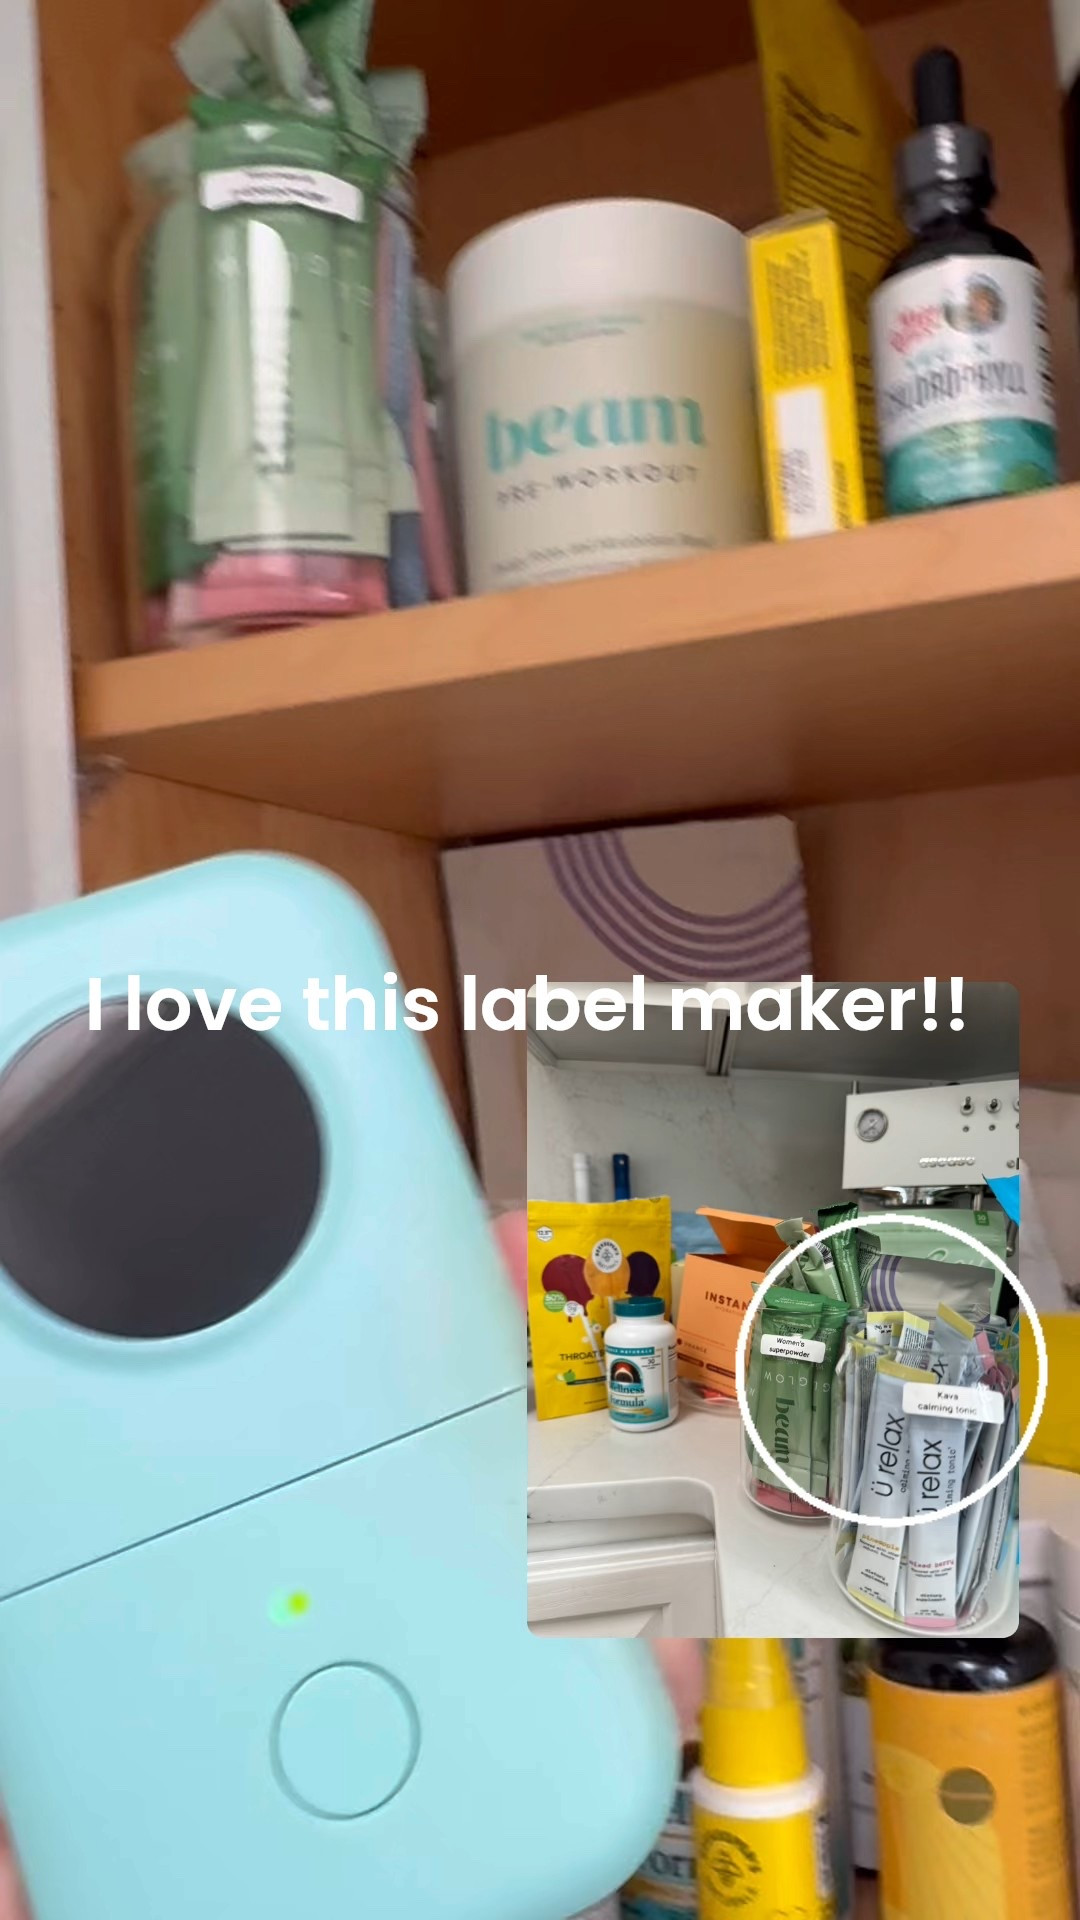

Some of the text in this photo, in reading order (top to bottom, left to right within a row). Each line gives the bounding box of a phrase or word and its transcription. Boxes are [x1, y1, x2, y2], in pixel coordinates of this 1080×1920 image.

[705, 1290, 752, 1312] INSTAN
[776, 1337, 805, 1348] Women's
[769, 1346, 810, 1358] superpowder
[764, 1371, 808, 1387] GLOW
[937, 1391, 959, 1401] Kava
[917, 1403, 953, 1414] calming
[774, 1397, 795, 1464] beam
[876, 1412, 905, 1476] relax
[916, 1438, 943, 1500] relax
